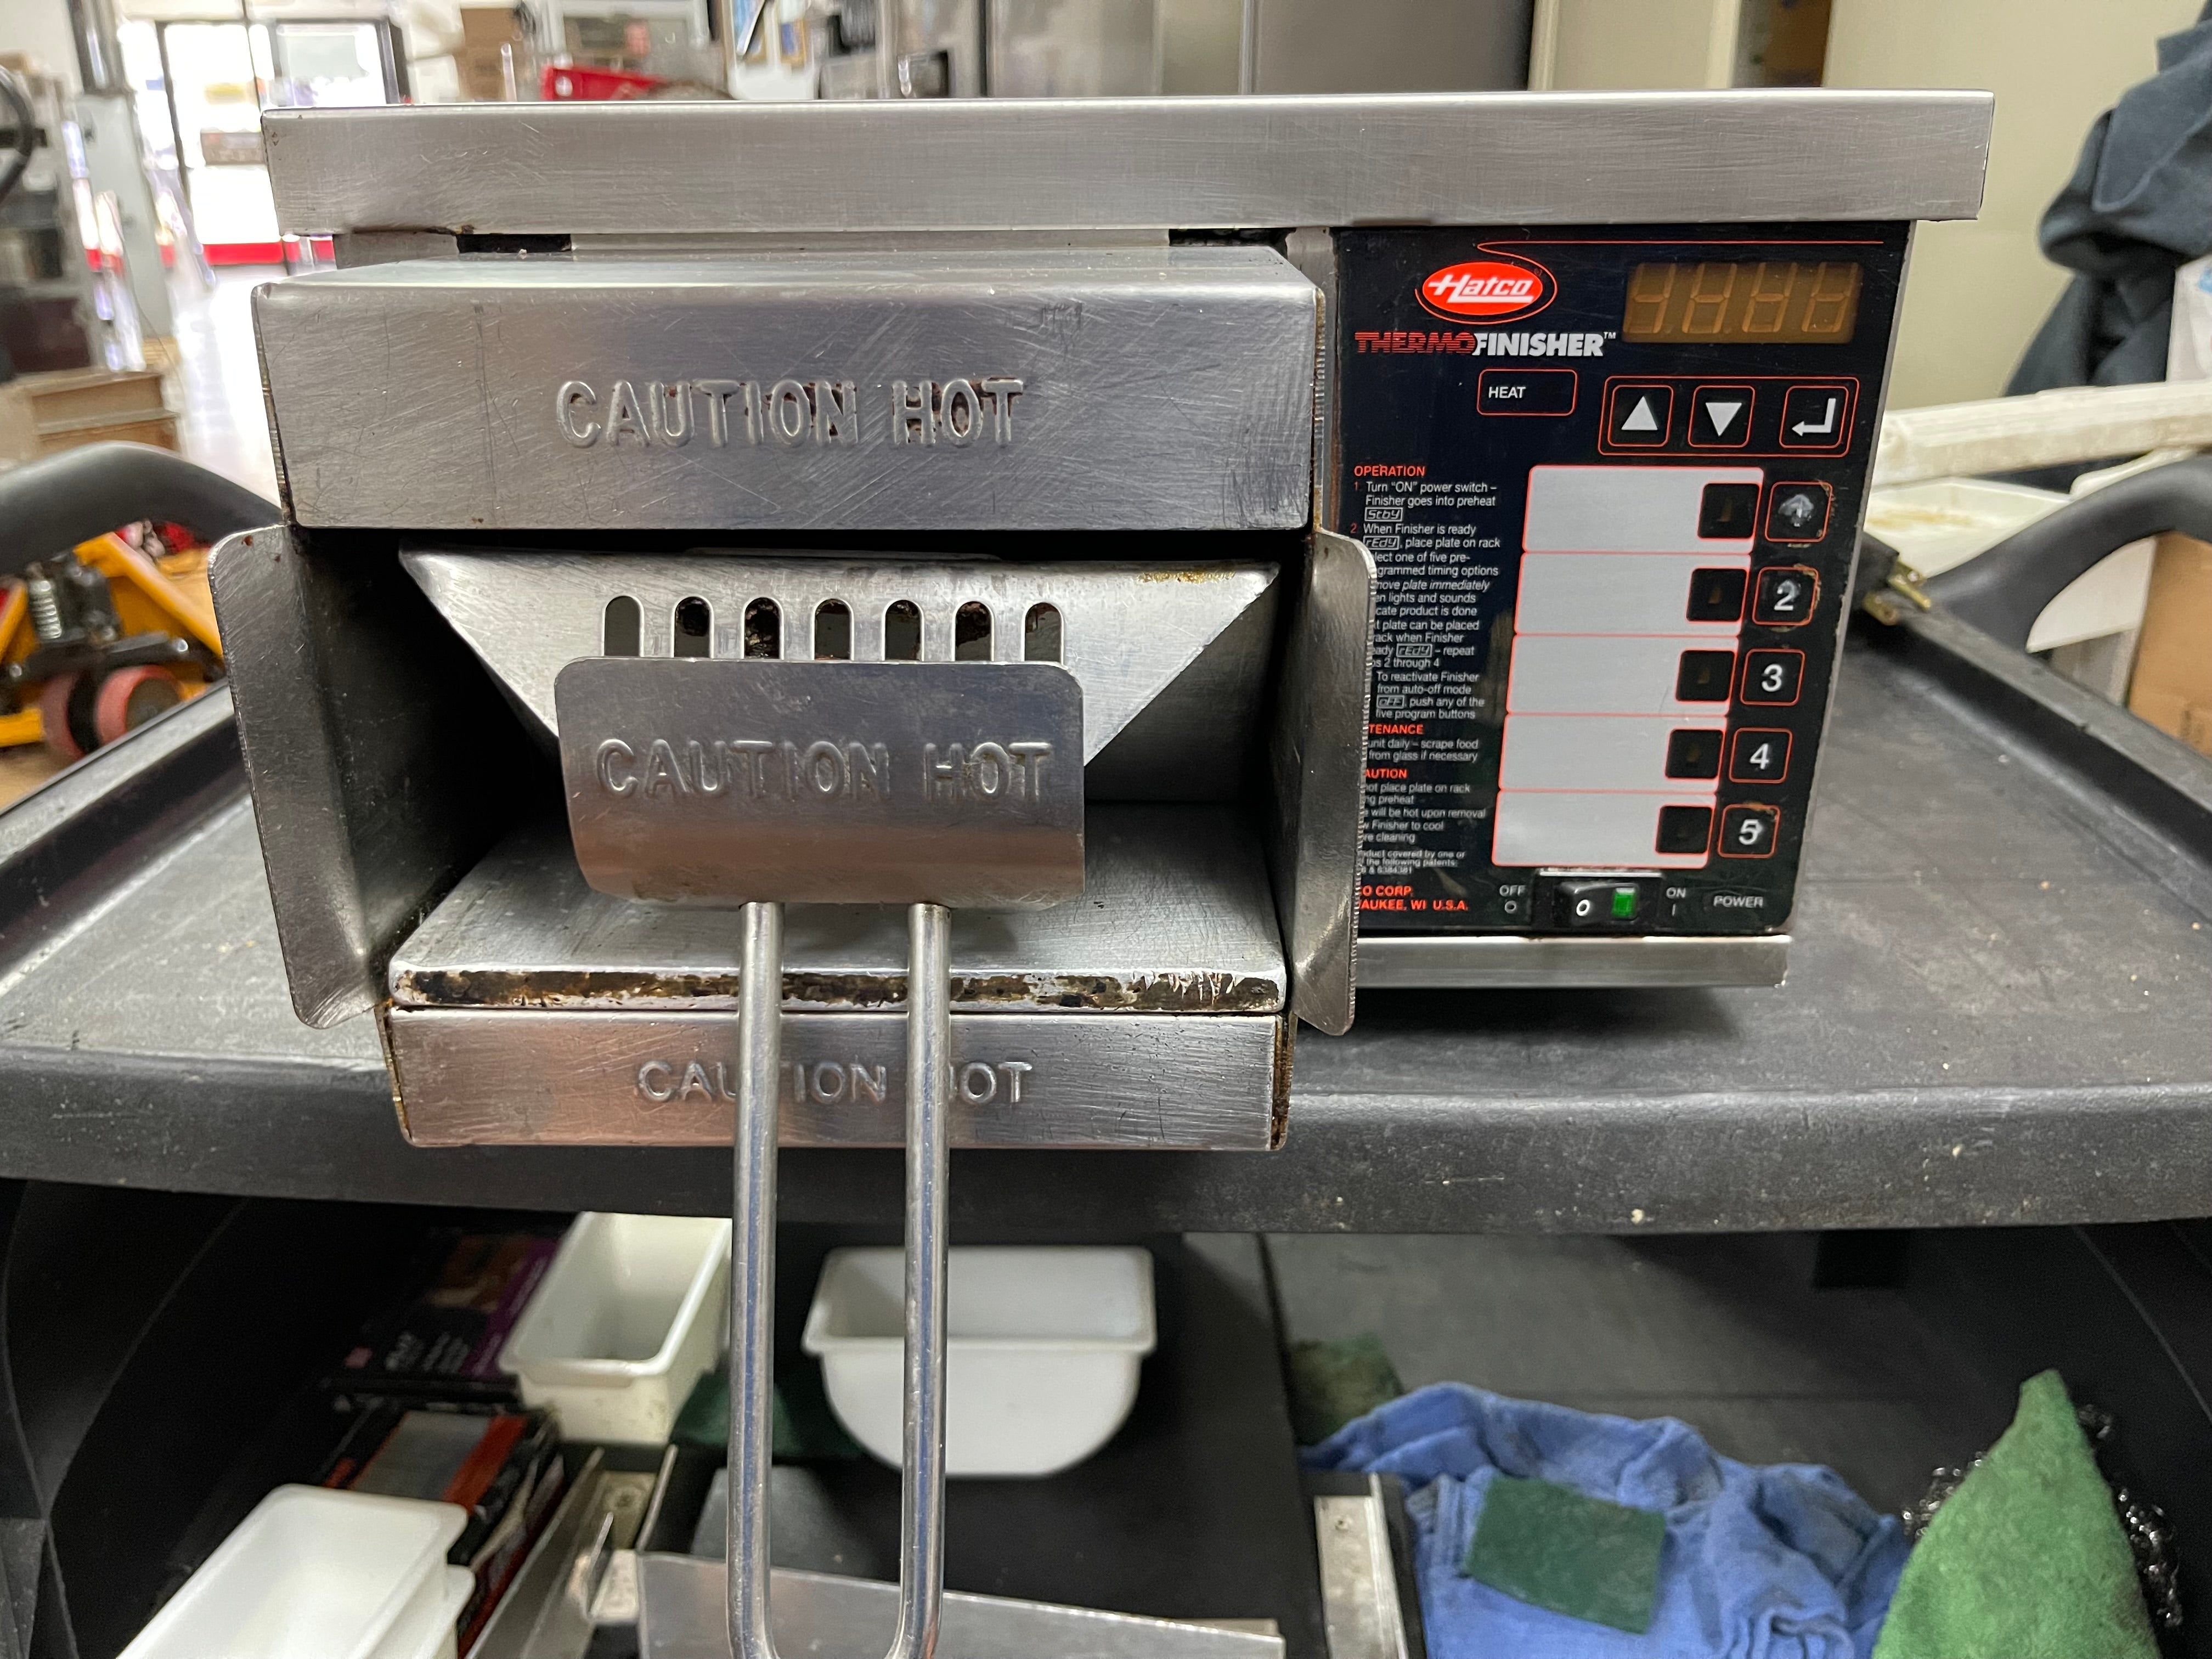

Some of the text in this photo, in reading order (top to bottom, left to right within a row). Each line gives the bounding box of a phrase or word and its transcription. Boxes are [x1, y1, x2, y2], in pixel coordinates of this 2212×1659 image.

[1428, 274, 1534, 303] Hatco
[1488, 386, 1526, 398] HEAT
[555, 377, 1025, 449] CAUTION HOT
[1354, 466, 1426, 477] OPERATION
[1366, 481, 1387, 492] Turn
[1420, 484, 1452, 494] power
[1455, 482, 1487, 492] switch
[1365, 495, 1496, 508] Finisher goes into preheat
[1350, 523, 1476, 537] 2 When Finisher is ready
[1405, 537, 1432, 549] place
[1435, 537, 1460, 550] plate
[1463, 539, 1476, 548] on
[1479, 538, 1500, 548] rack
[1395, 554, 1414, 562] one
[1417, 551, 1427, 562] of
[1430, 551, 1447, 562] five
[1428, 566, 1458, 578] timing
[1461, 566, 1499, 577] options
[1402, 579, 1427, 591] plate
[1430, 579, 1490, 592] immediately
[1389, 592, 1415, 605] lights
[1418, 592, 1436, 602] and
[1440, 593, 1476, 602] sounds
[1774, 579, 1801, 611] 2
[1400, 605, 1437, 617] product
[1441, 606, 1449, 616] is
[1452, 607, 1477, 616] done
[1383, 620, 1407, 632] plate
[1431, 619, 1443, 630] be
[1446, 620, 1479, 631] placed
[1396, 633, 1422, 642] when
[1425, 634, 1464, 643] Finisher
[1443, 645, 1475, 657] repeat
[1384, 658, 1390, 667] 2
[1393, 658, 1431, 670] through
[1434, 658, 1439, 666] 4
[1376, 671, 1480, 682] To reactivate Finisher
[1762, 664, 1782, 692] 3
[1377, 684, 1471, 695] from auto-off mode
[1409, 696, 1433, 708] push
[1436, 698, 1454, 709] any
[1457, 696, 1467, 707] of
[1469, 697, 1485, 707] the
[1376, 708, 1476, 721] five program buttons
[1387, 738, 1410, 751] daily
[1421, 740, 1454, 750] scrape
[1456, 738, 1479, 749] food
[1369, 749, 1477, 763] from glass if necessary
[1750, 743, 1769, 770] 4
[592, 738, 1052, 802] CAUTION HOT
[1380, 782, 1406, 794] place
[1409, 782, 1432, 794] plate
[1450, 783, 1470, 793] rack
[1378, 795, 1414, 805] preheat
[1371, 807, 1386, 816] will
[1389, 808, 1401, 817] be
[1403, 808, 1419, 817] hot
[1448, 809, 1485, 817] removal
[1372, 820, 1409, 830] Finisher
[1411, 821, 1420, 831] to
[1376, 832, 1415, 844] cleaning
[1739, 819, 1763, 845] 5
[1499, 885, 1525, 896] OFF
[1666, 888, 1686, 899] ON
[1410, 900, 1426, 910] WI
[1713, 896, 1763, 908] POWER
[637, 1060, 887, 1104] CAUION
